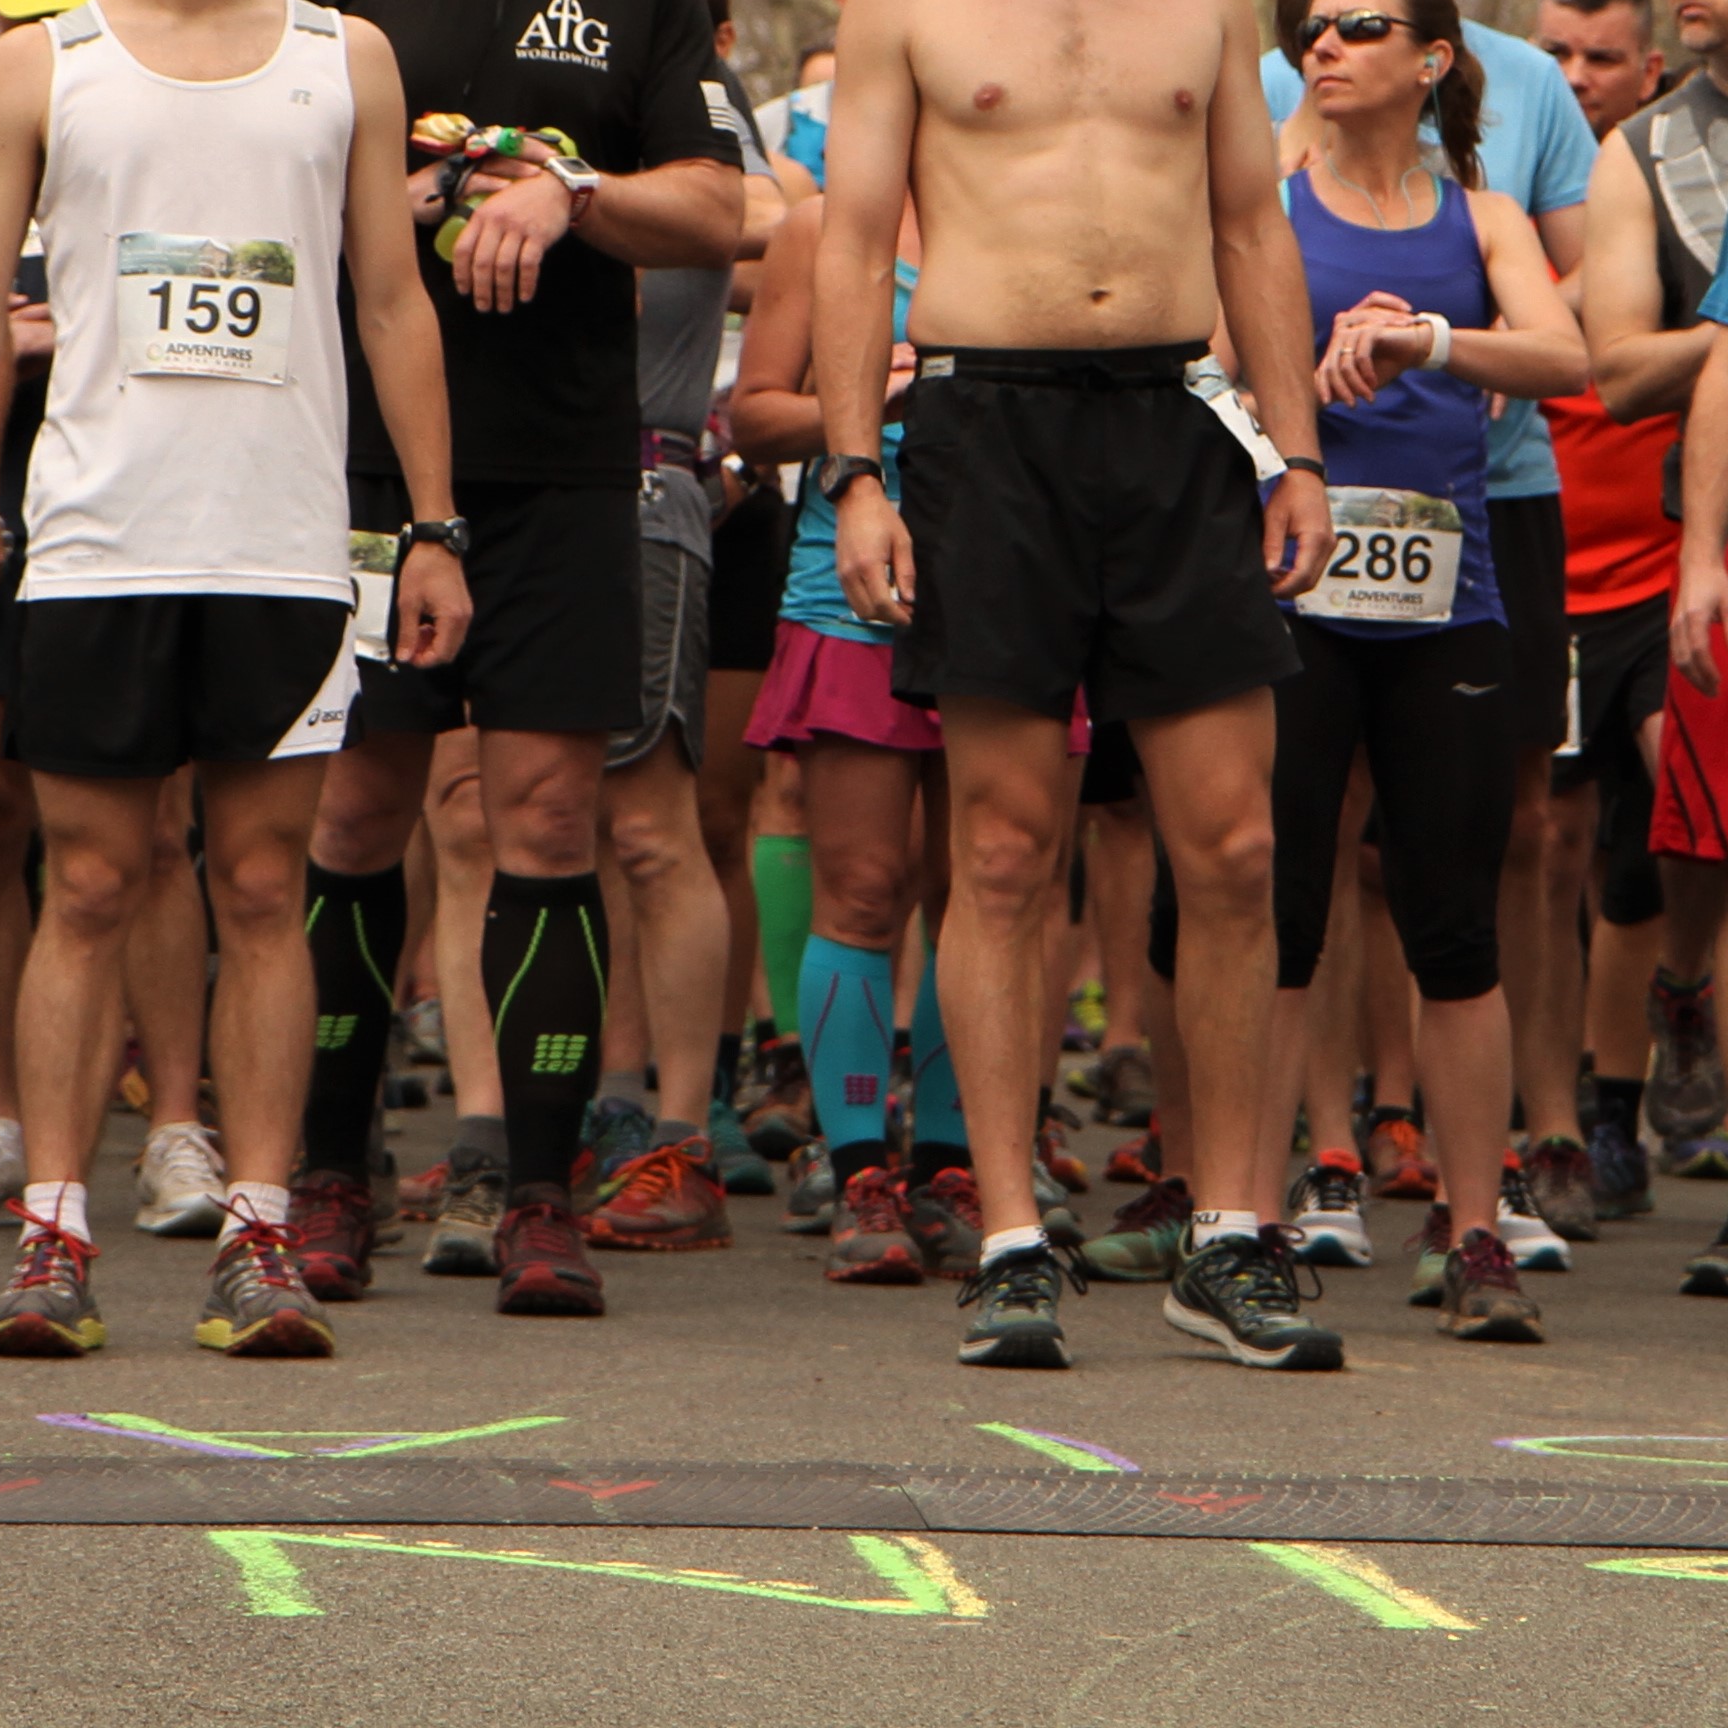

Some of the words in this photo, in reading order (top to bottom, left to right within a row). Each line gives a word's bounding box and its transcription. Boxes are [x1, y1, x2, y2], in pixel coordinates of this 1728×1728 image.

[515, 47, 609, 72] WORLDWIDE
[148, 280, 261, 338] 159
[166, 342, 253, 362] ADVENTURES
[1328, 530, 1432, 583] 286
[1347, 589, 1425, 604] ADVENTURES
